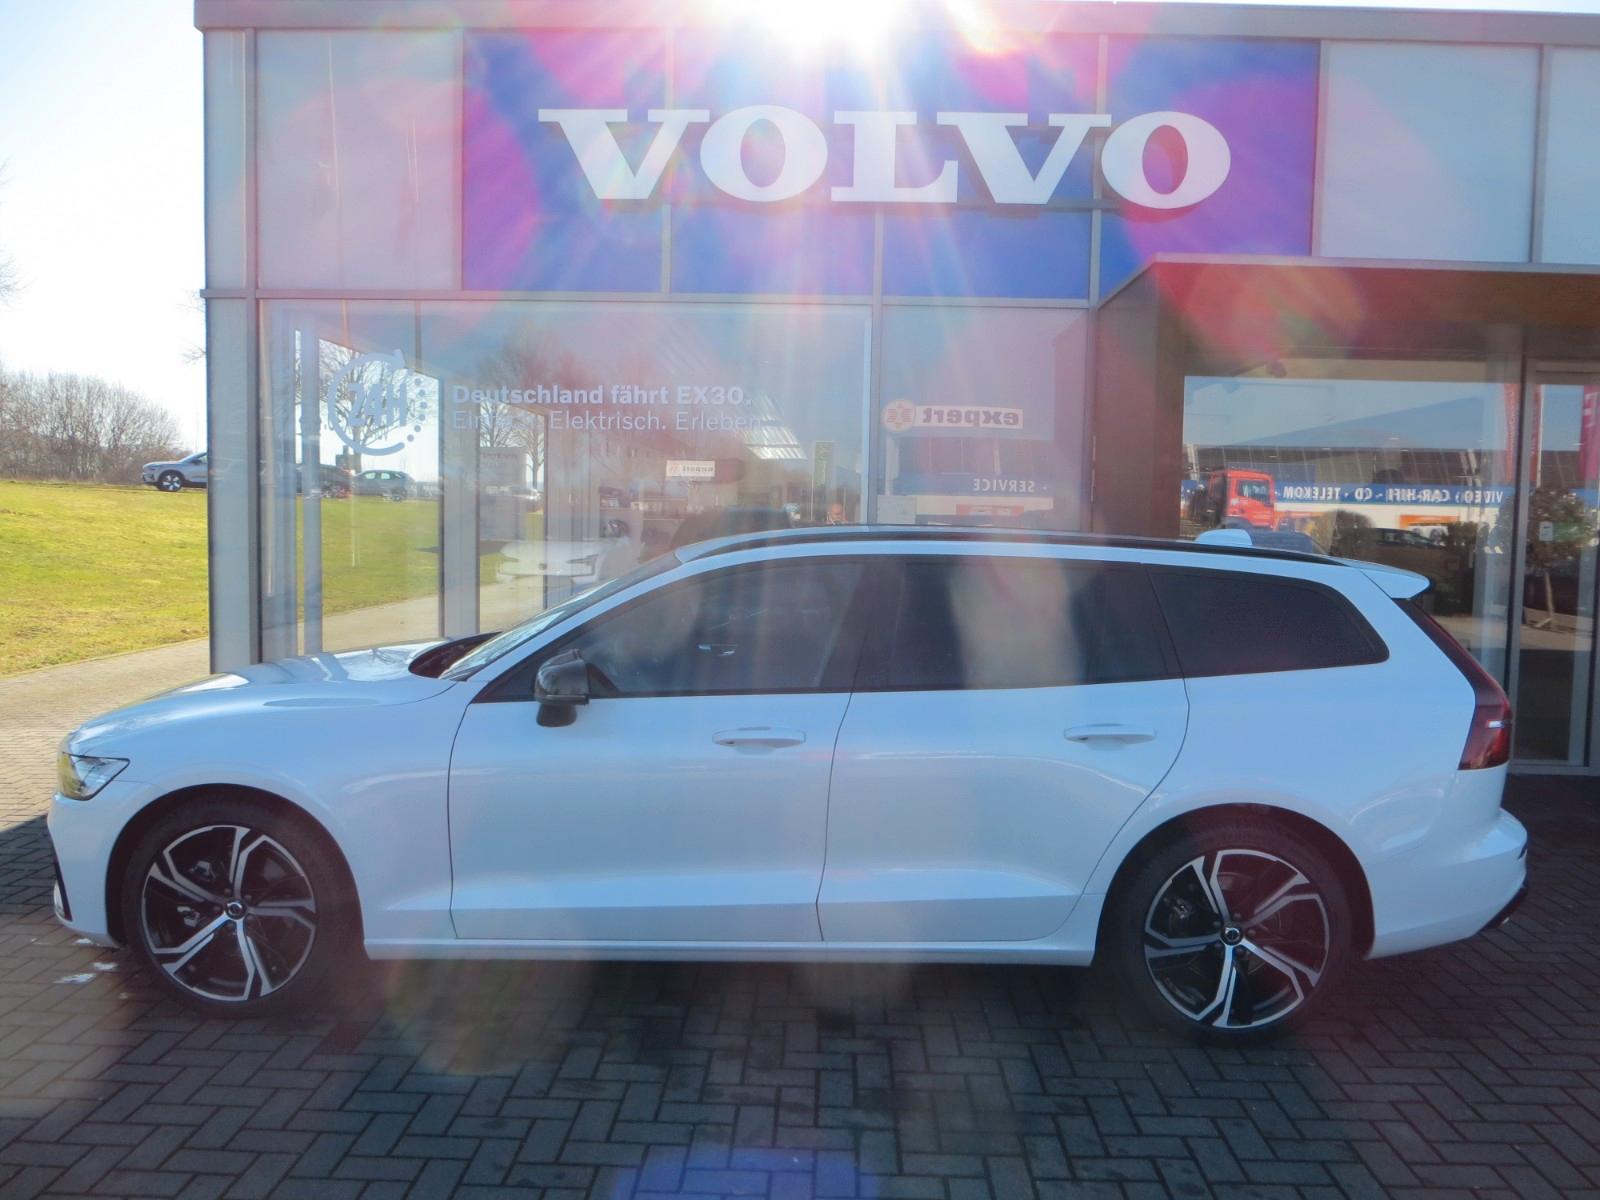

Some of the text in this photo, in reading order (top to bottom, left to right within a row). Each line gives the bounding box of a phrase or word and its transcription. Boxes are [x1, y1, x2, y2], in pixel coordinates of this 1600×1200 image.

[538, 105, 1231, 208] VOLVO
[452, 384, 603, 405] Deutschland
[611, 384, 669, 405] fährt
[550, 410, 667, 431] Elektrisch.
